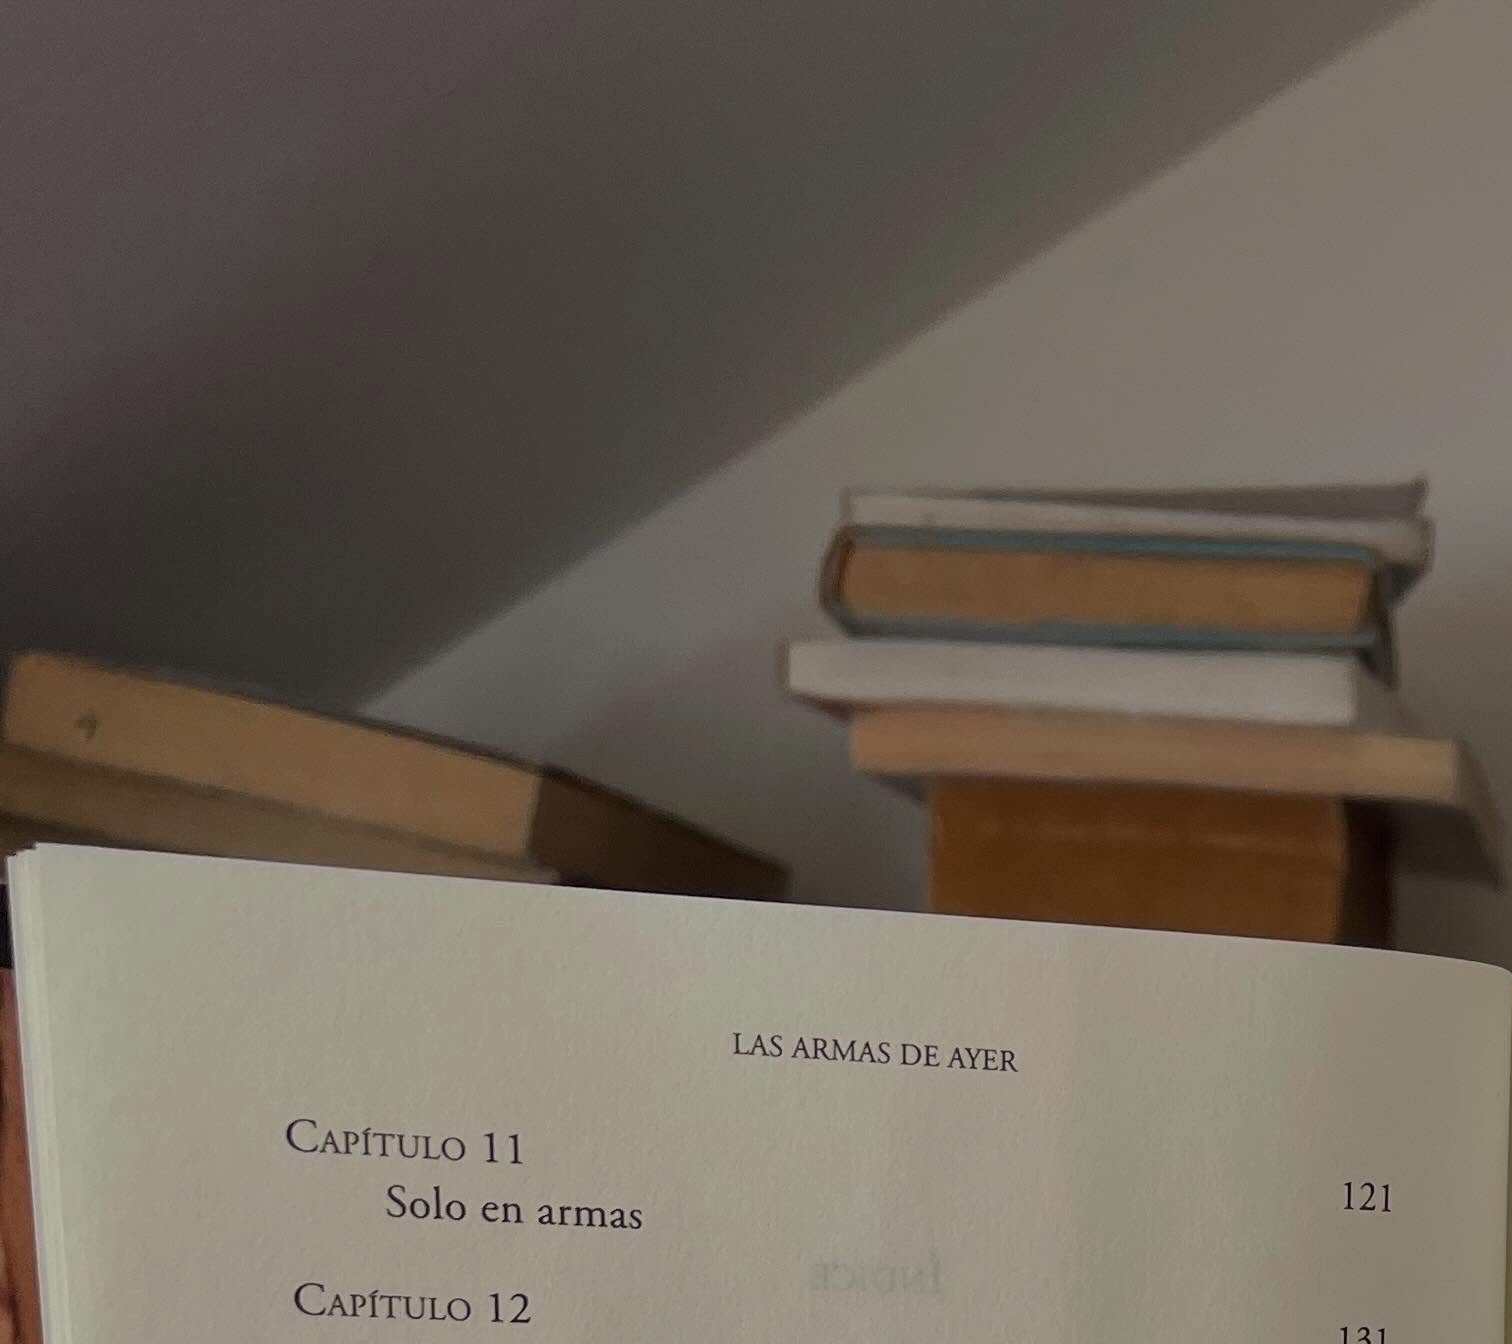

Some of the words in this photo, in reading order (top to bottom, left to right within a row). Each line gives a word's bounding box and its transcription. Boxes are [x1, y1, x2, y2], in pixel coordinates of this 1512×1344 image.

[733, 1033, 782, 1057] LAS
[792, 1037, 890, 1064] ARMAS
[901, 1044, 940, 1067] DE
[947, 1048, 1018, 1072] AYER
[286, 1119, 465, 1161] CAPÍTULO
[484, 1133, 522, 1164] 11
[386, 1185, 466, 1221] Solo
[482, 1202, 523, 1223] en
[538, 1205, 642, 1229] armas
[1344, 1182, 1390, 1212] 121
[294, 1283, 471, 1321] CAPÍTULO
[490, 1293, 531, 1323] 12
